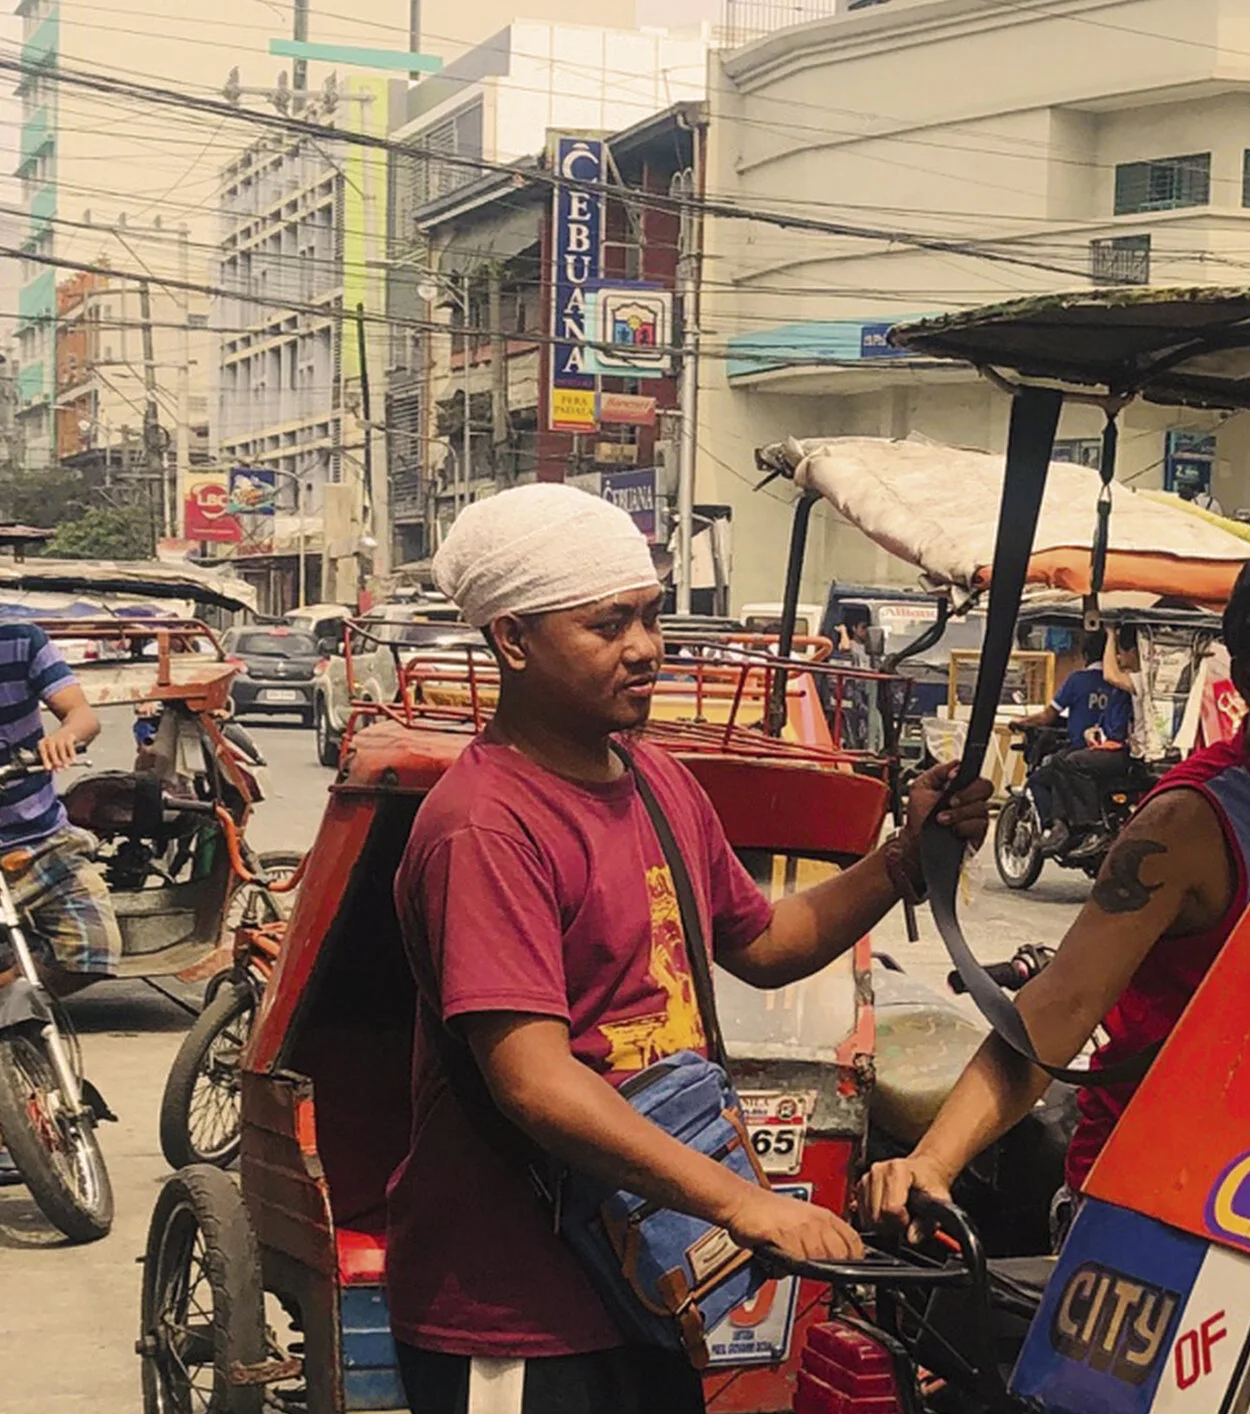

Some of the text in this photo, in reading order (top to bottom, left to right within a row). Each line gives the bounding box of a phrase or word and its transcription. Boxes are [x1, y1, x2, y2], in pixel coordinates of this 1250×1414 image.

[562, 147, 599, 373] CEBUANA
[197, 493, 230, 507] LBC
[1052, 1263, 1182, 1382] CITY
[1174, 1310, 1228, 1390] OF
